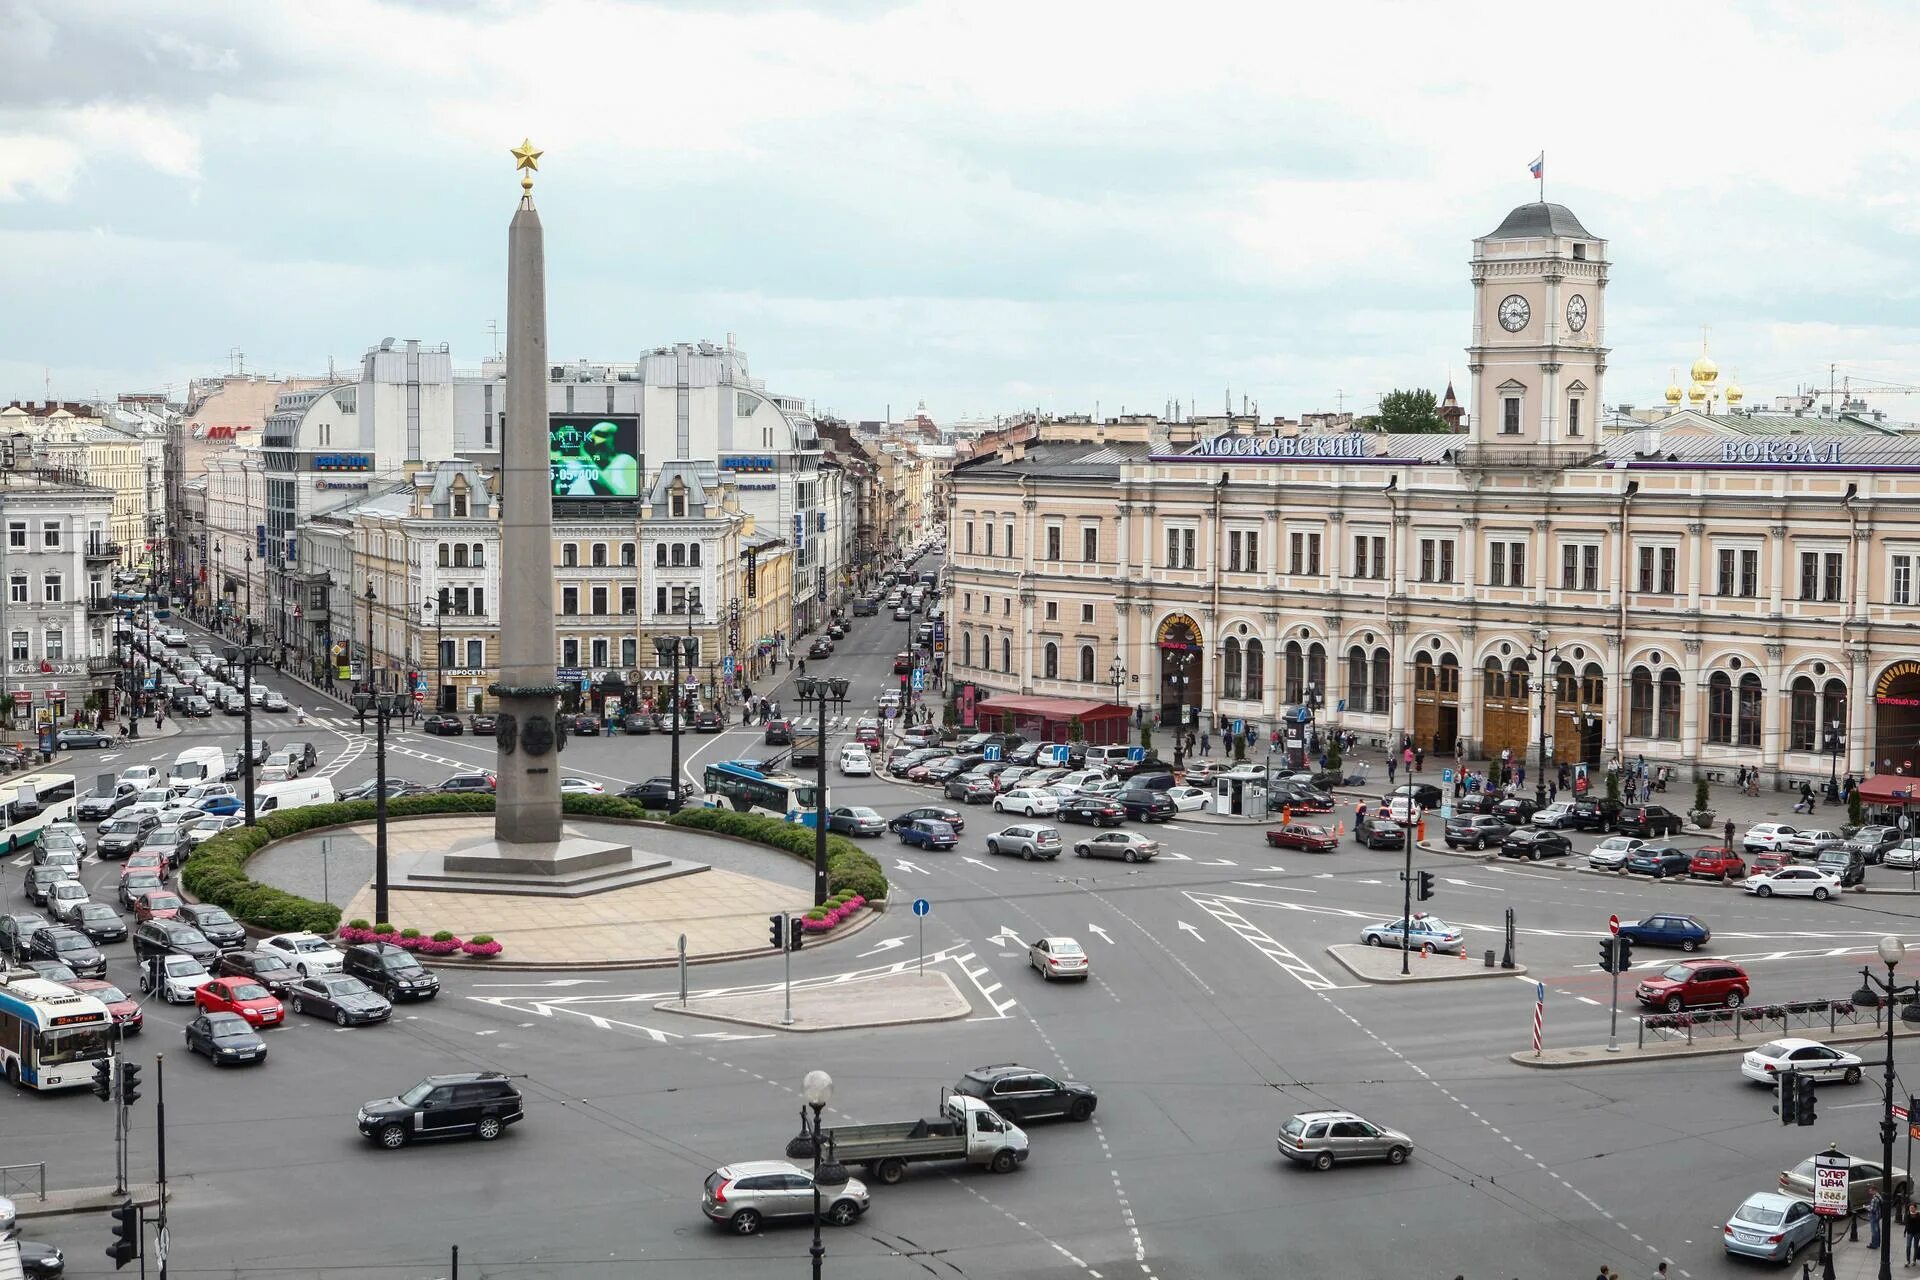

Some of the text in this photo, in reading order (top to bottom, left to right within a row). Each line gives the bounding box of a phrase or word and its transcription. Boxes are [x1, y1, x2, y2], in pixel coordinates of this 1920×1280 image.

[1199, 431, 1364, 457] МОСКОВСКИЙ
[1721, 441, 1841, 464] ВОКЗАЛ
[314, 453, 369, 469] park inn
[723, 455, 774, 469] park inn
[327, 482, 369, 490] PAULANER
[591, 671, 627, 682] КОЕ
[1818, 1169, 1846, 1180] СУПЕР
[1820, 1179, 1845, 1188] ЦЕНА
